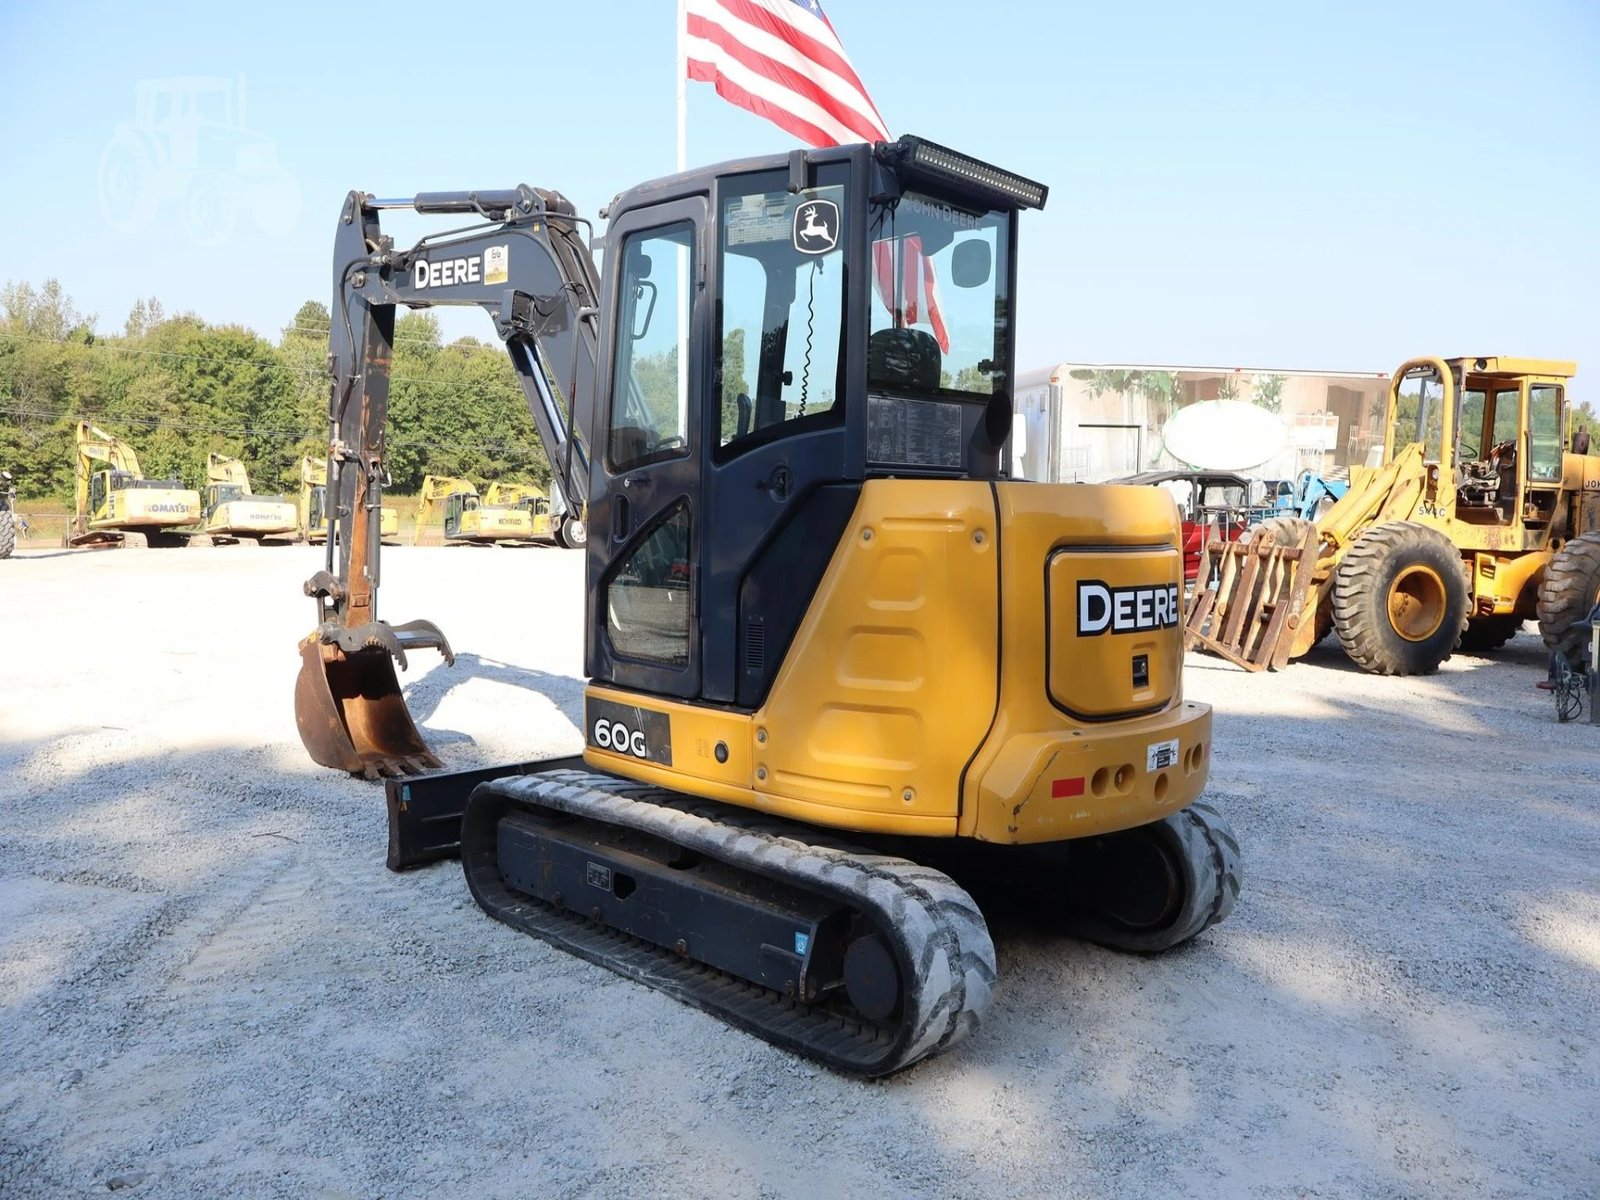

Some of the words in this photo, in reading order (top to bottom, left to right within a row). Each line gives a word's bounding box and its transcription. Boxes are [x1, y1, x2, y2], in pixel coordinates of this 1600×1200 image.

[904, 196, 940, 221] JOHN
[942, 204, 981, 232] DEERE
[415, 257, 481, 290] DEERE
[1080, 584, 1178, 633] DEERE
[594, 718, 646, 758] 60G
